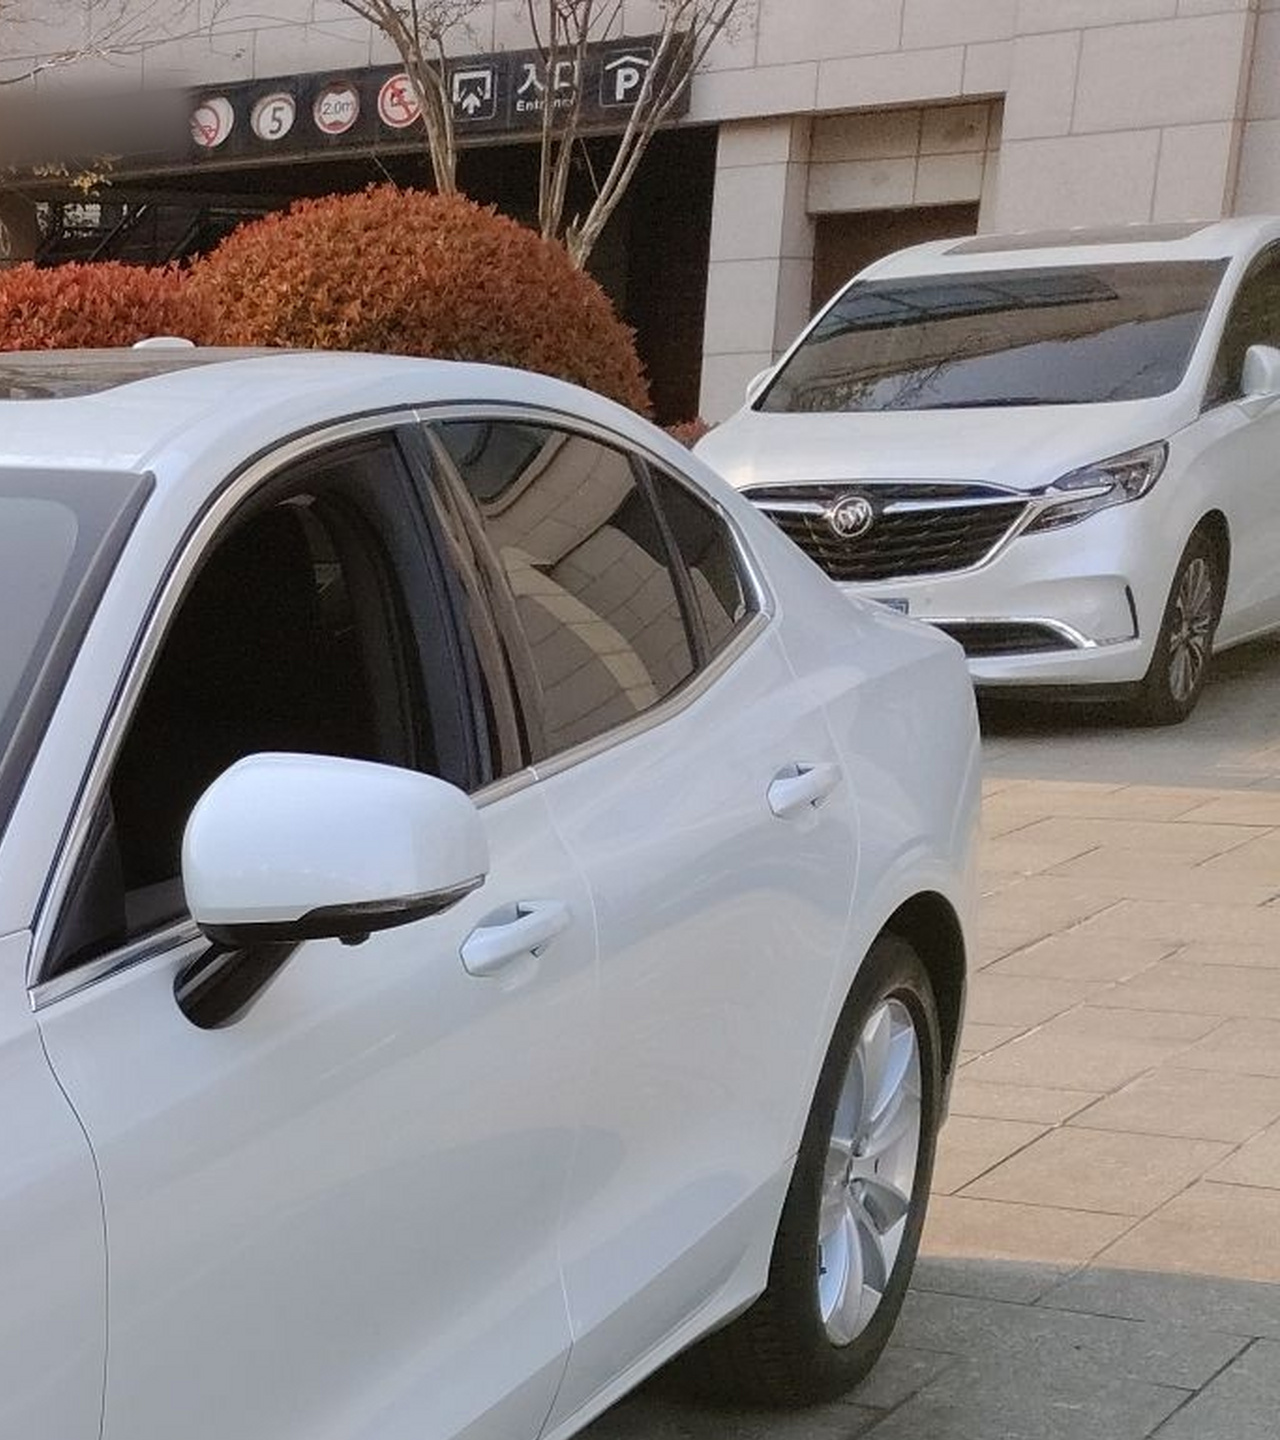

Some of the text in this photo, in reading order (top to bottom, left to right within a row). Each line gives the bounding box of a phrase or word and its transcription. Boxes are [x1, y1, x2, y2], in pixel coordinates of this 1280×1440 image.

[517, 61, 578, 94] 入口
[616, 67, 639, 101] P
[269, 106, 285, 134] 5
[323, 101, 353, 115] 2.0m
